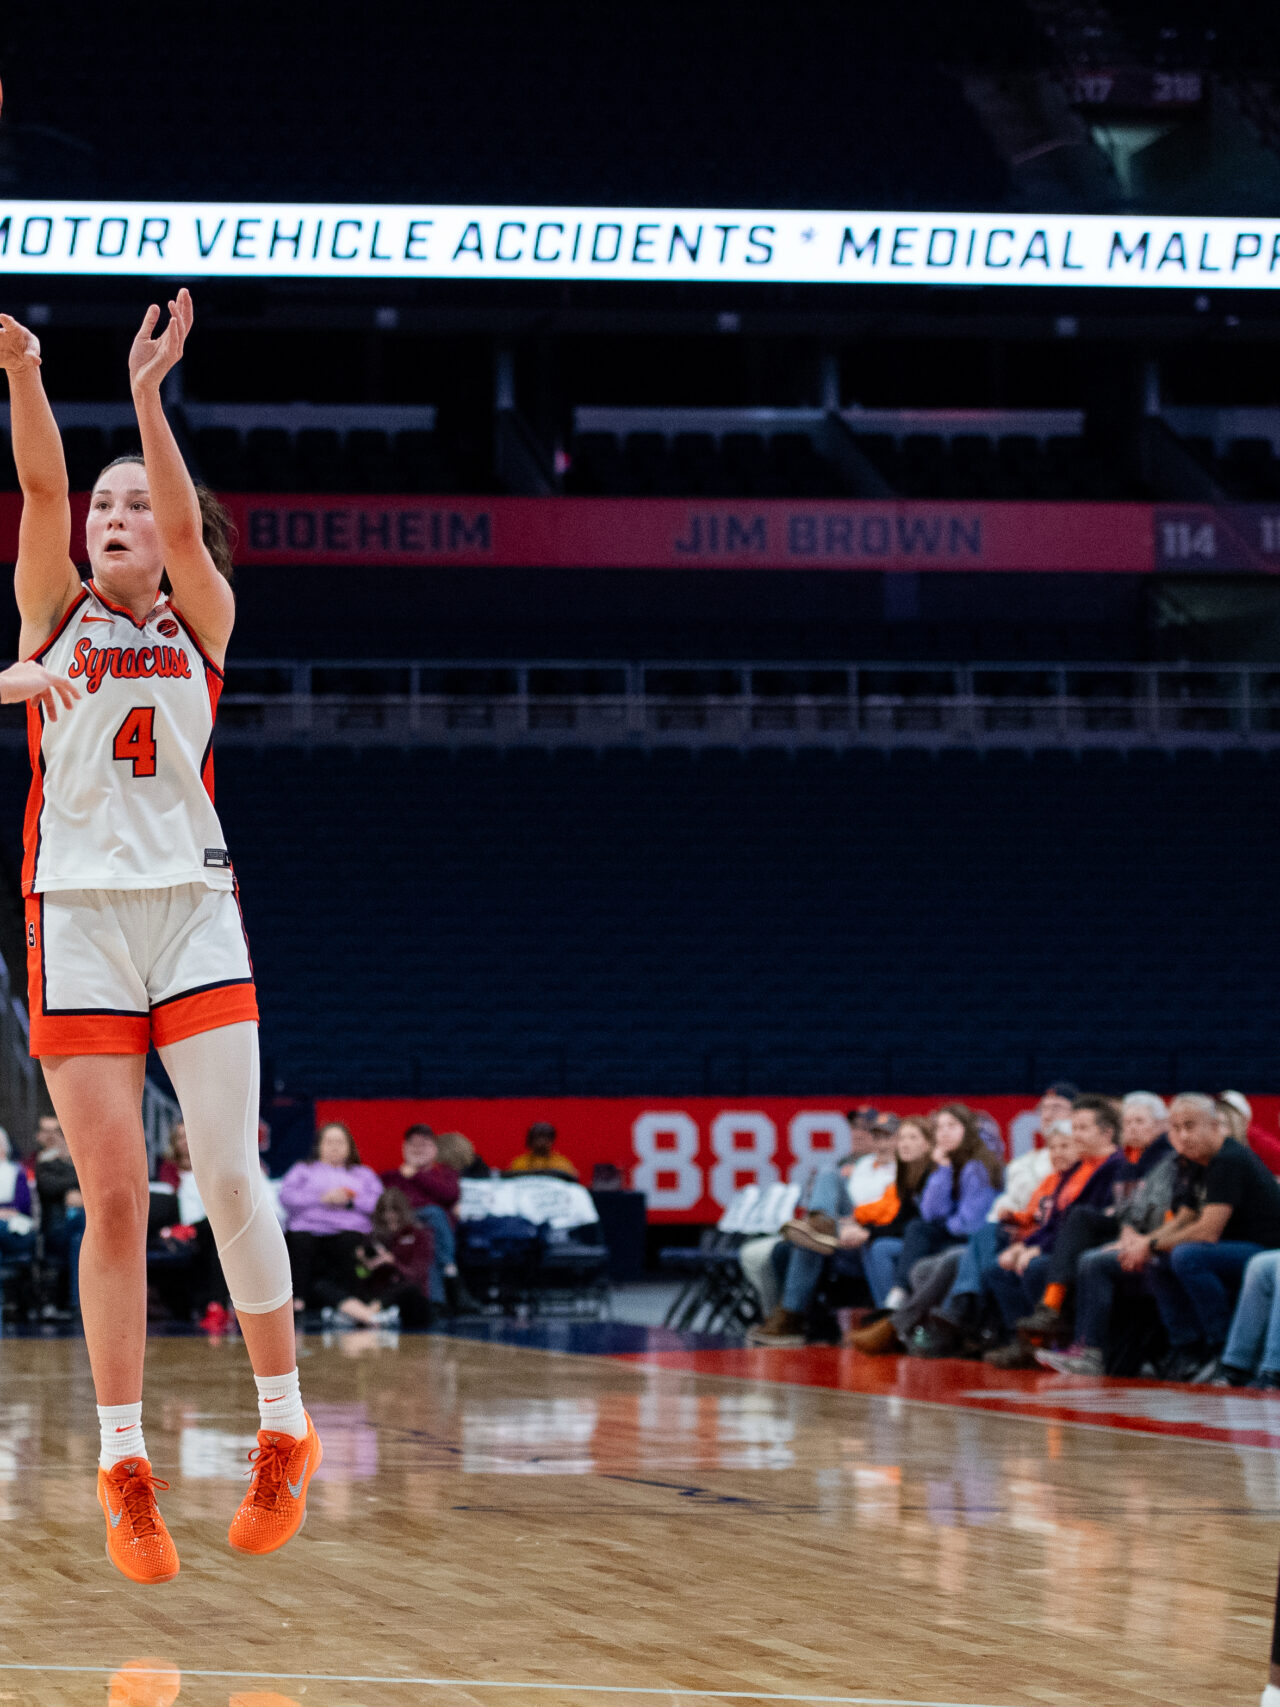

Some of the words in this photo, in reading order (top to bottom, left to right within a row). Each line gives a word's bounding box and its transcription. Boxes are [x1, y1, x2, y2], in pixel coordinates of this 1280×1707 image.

[195, 218, 435, 261] VEHICLE
[452, 221, 777, 266] ACCIDENTS
[838, 226, 1085, 270] MEDICAL
[248, 509, 493, 552] BOEHEIM
[674, 513, 768, 555] JIM
[788, 515, 983, 557] BROWN
[1161, 520, 1218, 559] 114
[68, 637, 192, 694] Syracuse
[112, 706, 157, 778] 4
